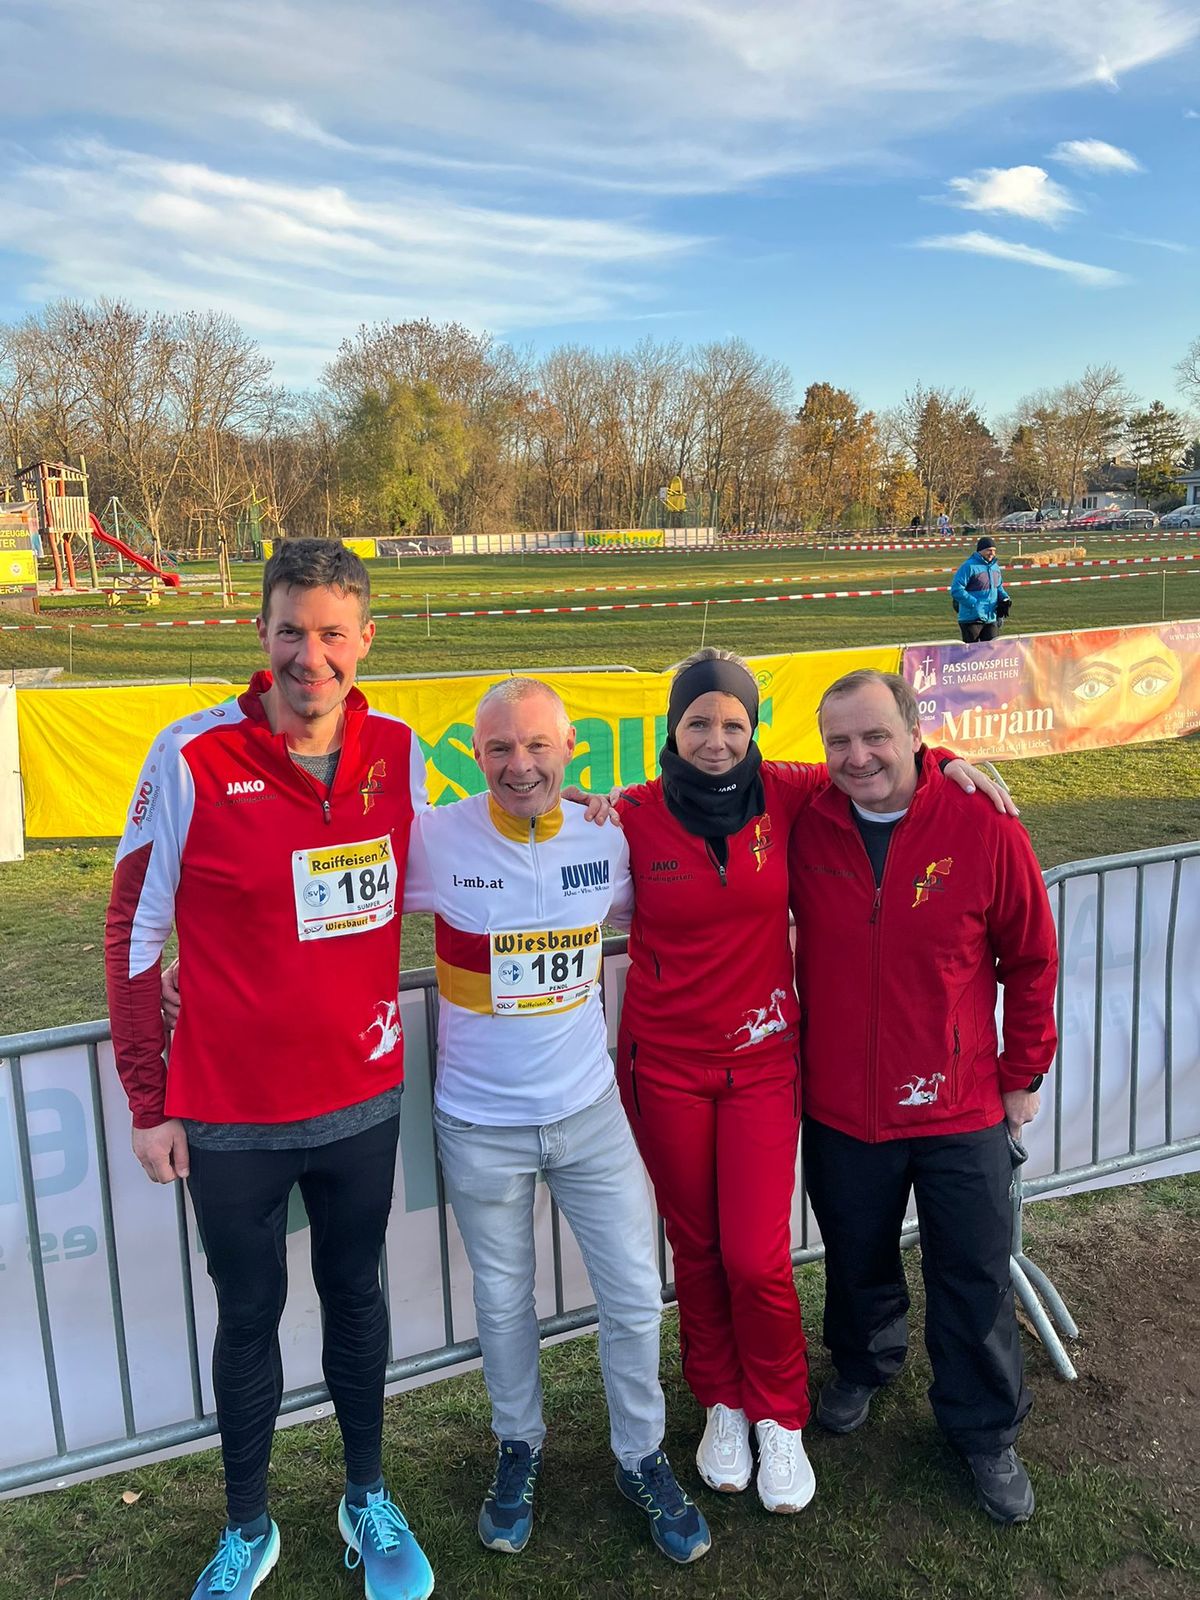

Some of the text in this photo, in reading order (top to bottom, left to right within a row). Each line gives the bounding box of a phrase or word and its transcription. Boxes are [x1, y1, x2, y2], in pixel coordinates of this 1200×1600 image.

[942, 657, 1019, 673] PASSIONSSPIELE
[942, 669, 1019, 685] ST. MARGARETHEN
[918, 700, 936, 714] 00
[940, 702, 1055, 743] Mirjam
[226, 779, 265, 795] JAKO
[311, 853, 378, 872] Raiffeisen
[651, 860, 678, 872] JAKO
[453, 875, 504, 889] l-mb.at
[560, 859, 609, 890] JUVINA
[337, 864, 390, 905] 184
[357, 900, 381, 911] SUMPER
[494, 926, 599, 953] Wiesbauer
[531, 949, 584, 985] 181
[517, 1001, 547, 1010] Raiffeisen
